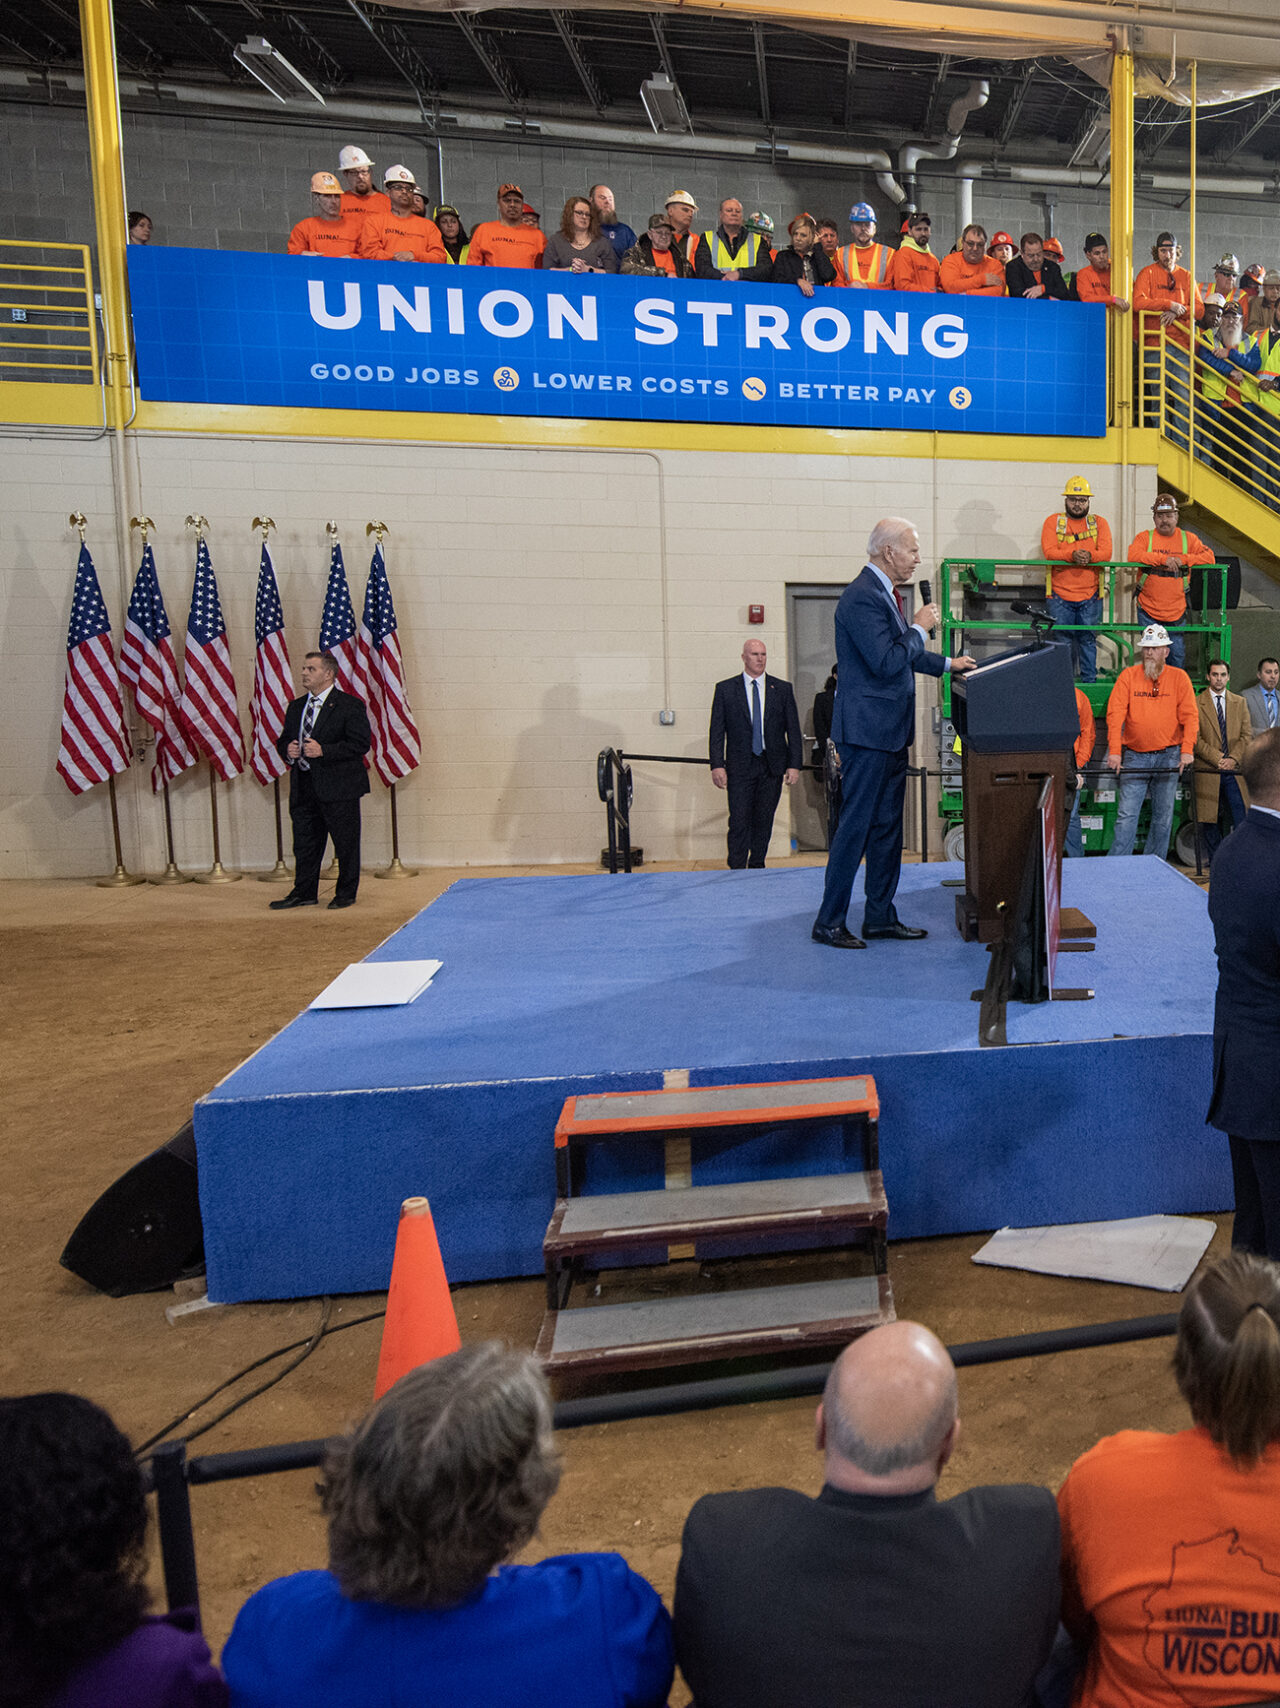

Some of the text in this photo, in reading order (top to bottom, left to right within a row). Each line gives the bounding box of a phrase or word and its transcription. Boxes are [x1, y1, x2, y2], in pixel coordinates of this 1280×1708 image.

[308, 279, 970, 360] UNION STRONG
[310, 362, 937, 406] GOOD JOBS LOWER COSTS BETTER PAY
